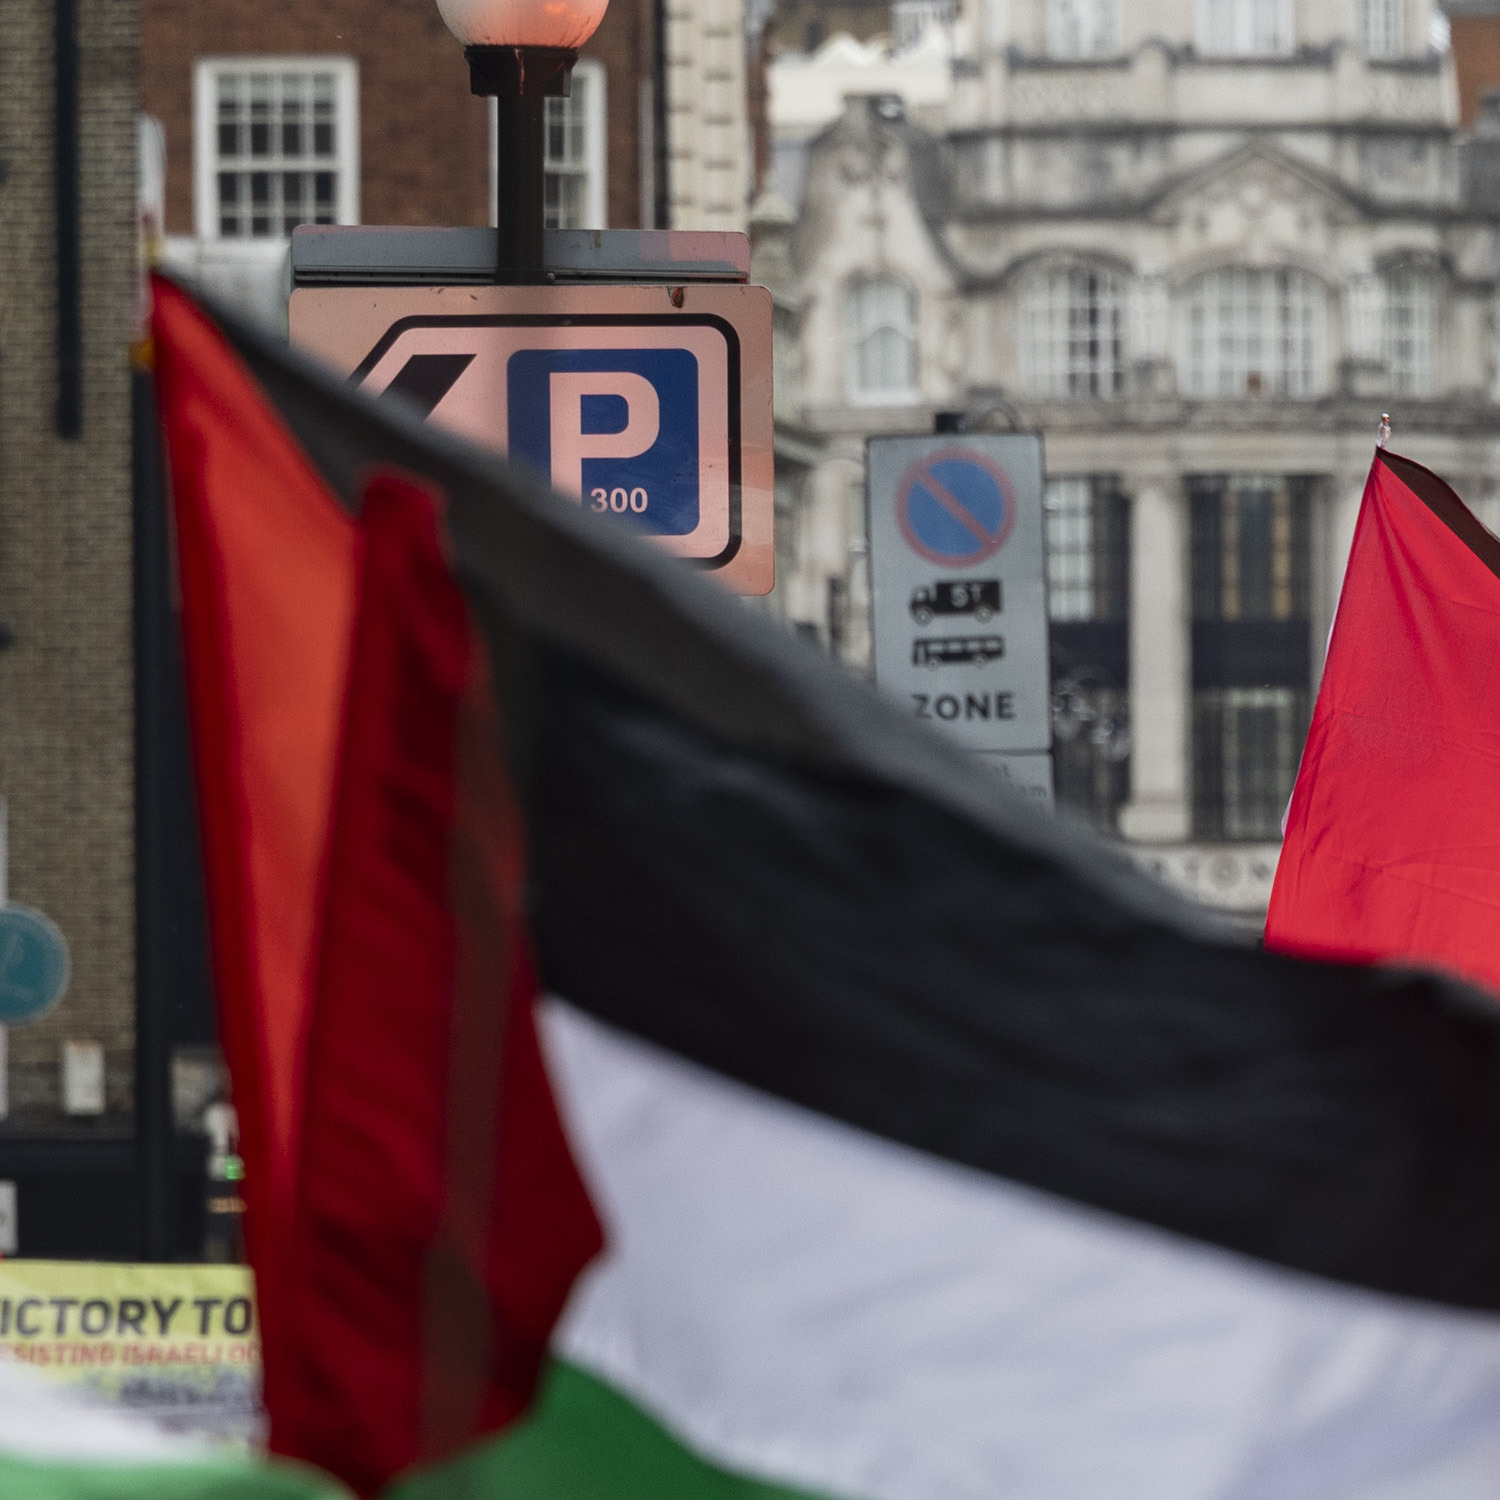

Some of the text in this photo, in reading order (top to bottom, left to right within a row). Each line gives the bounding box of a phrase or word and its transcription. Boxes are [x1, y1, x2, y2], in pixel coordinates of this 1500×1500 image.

[550, 372, 660, 507] P
[590, 487, 649, 514] 300
[910, 692, 1015, 721] ZONE
[193, 1299, 251, 1336] TO
